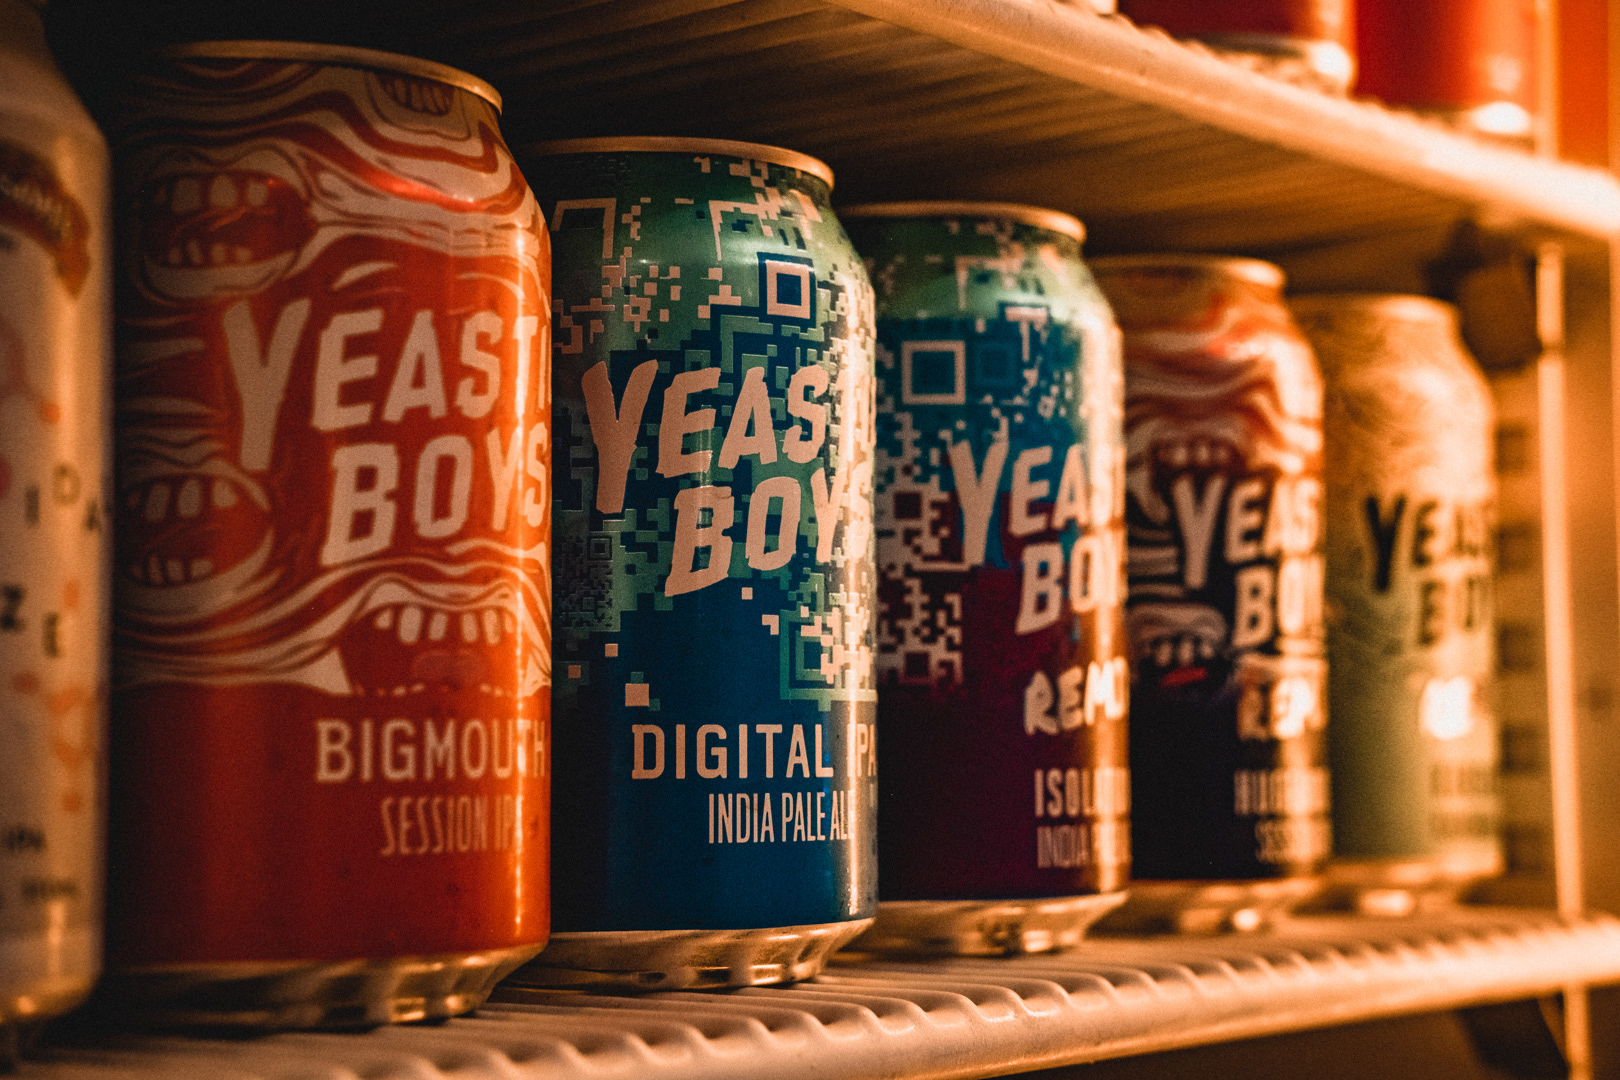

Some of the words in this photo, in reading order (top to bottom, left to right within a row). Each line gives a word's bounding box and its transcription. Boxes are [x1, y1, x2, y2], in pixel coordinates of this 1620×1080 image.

[320, 422, 548, 568] BOYS
[316, 718, 546, 783] BIGMOUTH
[631, 723, 834, 780] DIGITAL
[846, 723, 877, 777] IPA
[381, 796, 488, 856] SESSION
[708, 793, 775, 844] INDIA
[782, 791, 827, 842] PALE
